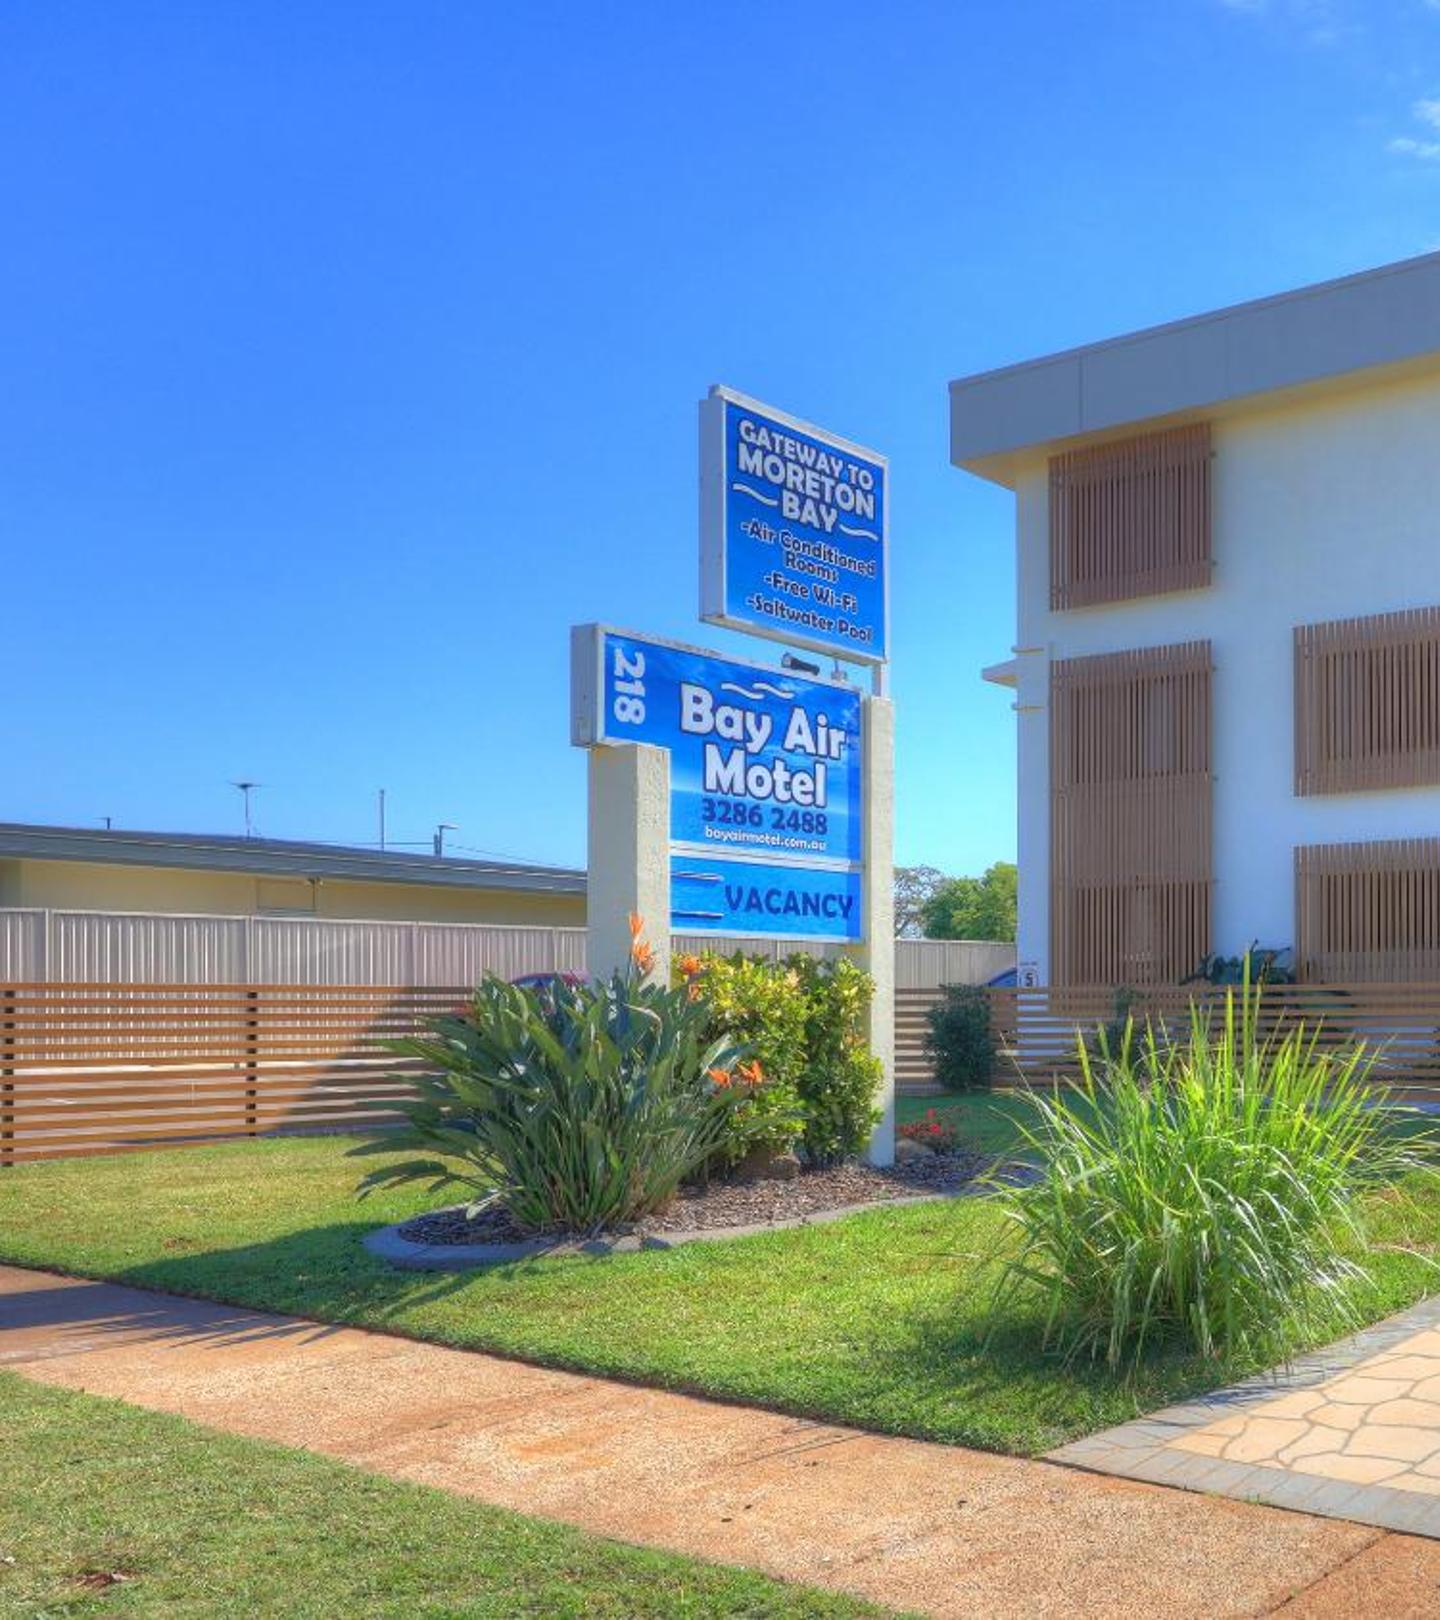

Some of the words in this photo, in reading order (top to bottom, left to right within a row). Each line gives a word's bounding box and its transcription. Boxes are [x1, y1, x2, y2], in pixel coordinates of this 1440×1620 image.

[739, 420, 843, 479] GATEWAY
[848, 464, 874, 491] TO
[738, 444, 875, 520] MORETON
[782, 491, 838, 533] BAY
[780, 531, 876, 577] Conditioned
[785, 552, 837, 582] Rooms
[814, 585, 857, 612] Wi-Fi
[838, 620, 872, 643] Pool
[613, 648, 646, 725] 218
[680, 681, 772, 754] Bay
[783, 707, 847, 760] Air
[704, 744, 827, 808] Motel
[702, 799, 763, 827] 3286
[770, 807, 828, 835] 2488
[704, 826, 827, 851] bayairmotel.com.au
[724, 885, 853, 919] VACANCY
